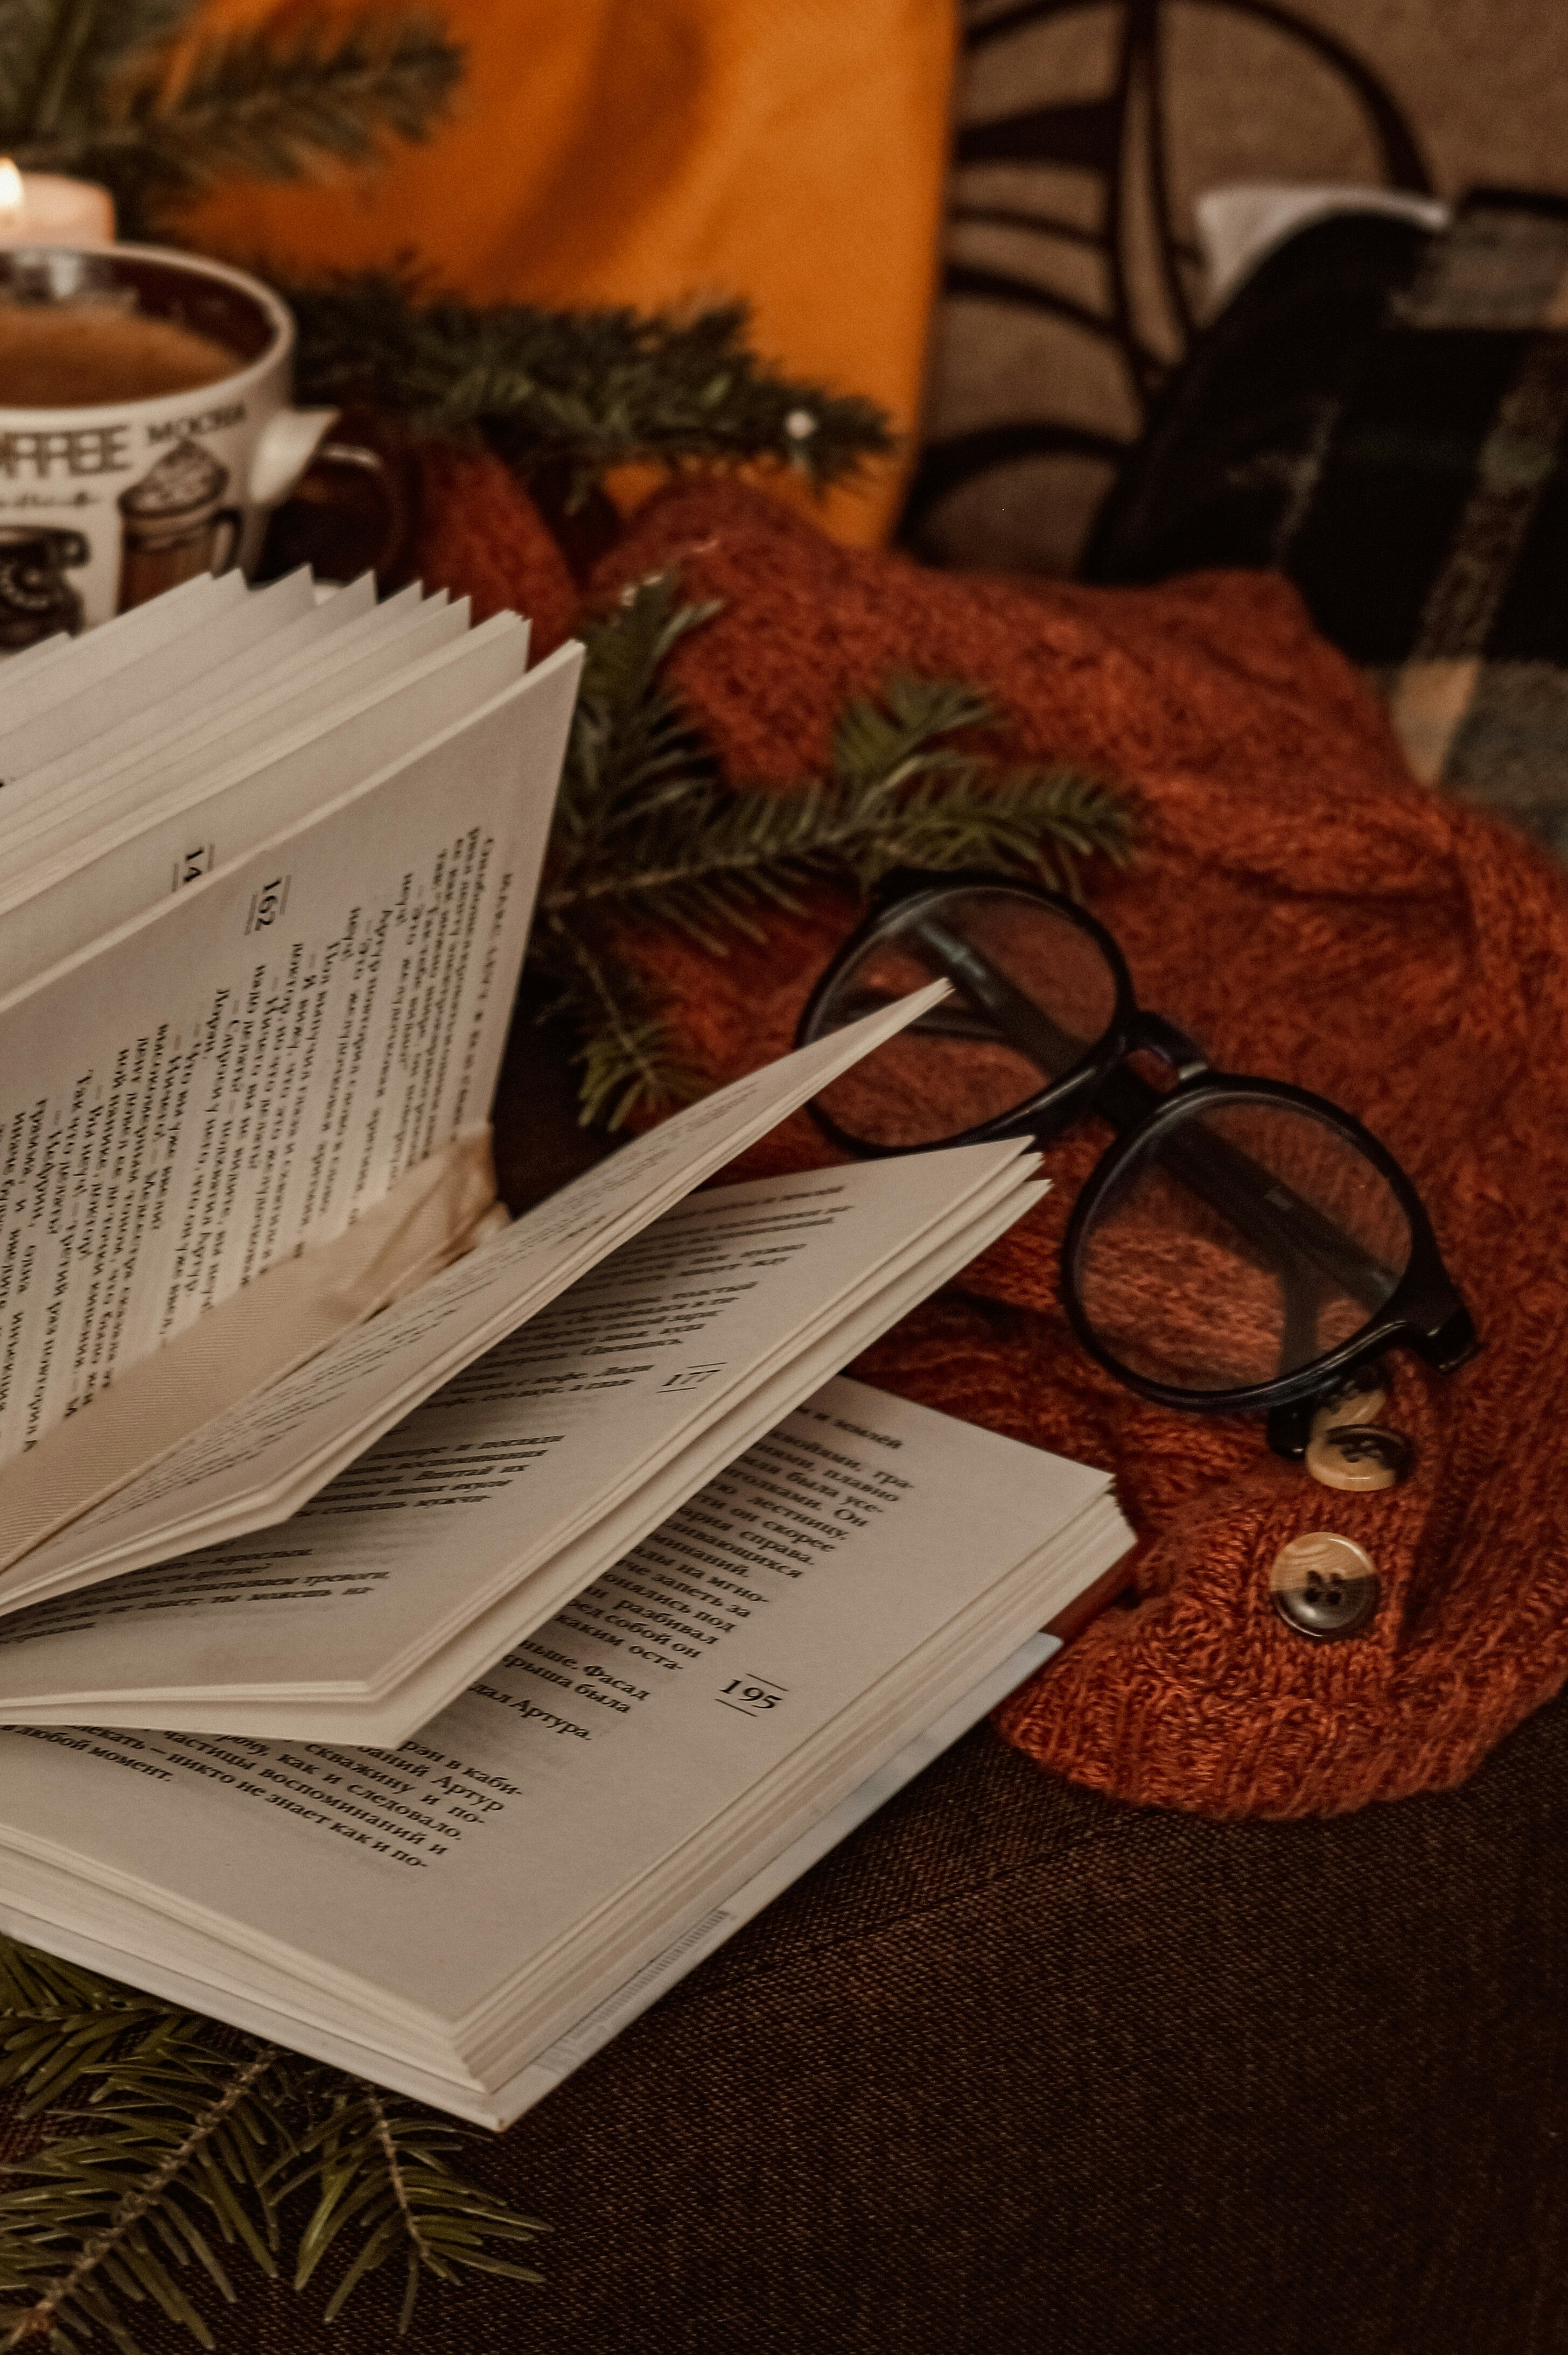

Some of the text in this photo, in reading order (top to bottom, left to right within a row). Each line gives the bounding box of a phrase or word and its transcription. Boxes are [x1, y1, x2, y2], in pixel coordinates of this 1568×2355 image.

[254, 877, 282, 933] 162
[662, 1369, 721, 1386] 177
[786, 1471, 840, 1498] была
[839, 1496, 884, 1513] усе-
[822, 1469, 900, 1502] плавно
[676, 1507, 816, 1566] ария справа.
[730, 1508, 761, 1522] он
[761, 1520, 836, 1552] скорее
[834, 1509, 870, 1527] Он
[647, 1533, 750, 1578] минаний.
[650, 1572, 724, 1608] запеть
[725, 1603, 752, 1618] за
[675, 1564, 706, 1579] на
[706, 1576, 771, 1603] мгно-
[604, 1613, 673, 1646] собой
[670, 1643, 702, 1659] он
[613, 1598, 719, 1646] разбивал
[694, 1611, 738, 1633] под
[517, 1639, 652, 1702] ньше. Фасад
[628, 1645, 685, 1671] оста-
[573, 1684, 632, 1714] была
[720, 1677, 783, 1710] 195
[508, 1699, 593, 1741] Артура.
[88, 1746, 174, 1783] момент.
[304, 1743, 486, 1825] скважину и по-
[444, 1760, 463, 1770] в
[461, 1767, 526, 1797] каби-
[162, 1730, 449, 1856] частицы воспоминаний и
[166, 1753, 236, 1784] никто
[234, 1781, 269, 1797] не
[264, 1793, 332, 1825] знает
[329, 1821, 374, 1845] как
[370, 1840, 392, 1853] и
[390, 1849, 429, 1868] по-
[276, 1753, 321, 1775] как
[323, 1772, 345, 1785] и
[346, 1783, 463, 1841] следовало.
[430, 1776, 505, 1813] Артур
